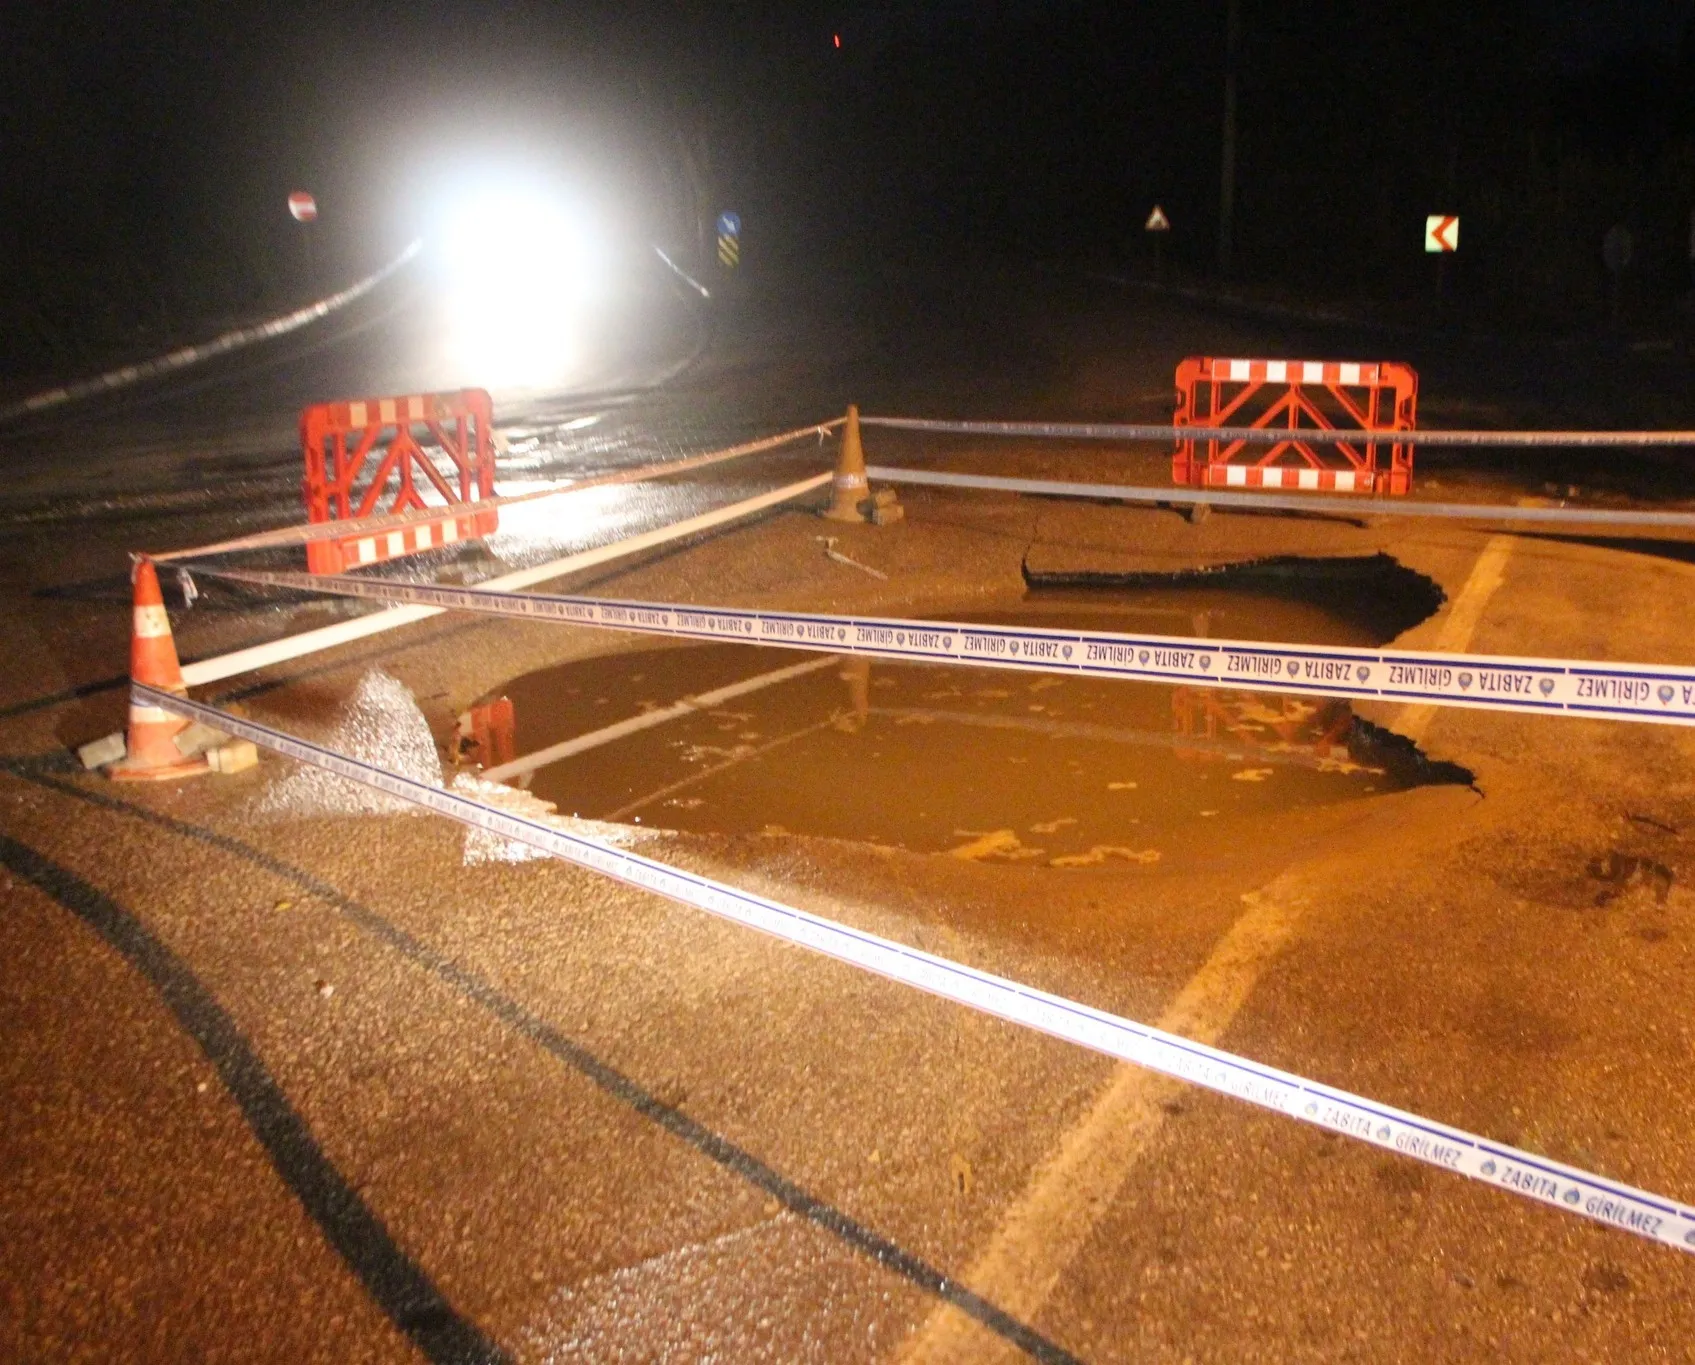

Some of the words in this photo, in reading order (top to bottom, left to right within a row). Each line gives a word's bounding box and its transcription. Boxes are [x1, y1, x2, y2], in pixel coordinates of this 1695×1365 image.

[807, 625, 835, 640] ZABITA
[856, 628, 893, 645] GİRİLMEZ
[909, 633, 939, 648] ZABITA
[964, 636, 1006, 655] GİRİLMEZ
[1023, 641, 1058, 658] ZABITA
[1086, 645, 1134, 665] GİRİLMEZ
[1155, 650, 1194, 669] ZABITA
[1227, 655, 1282, 678] GİRİLMEZ
[1305, 660, 1352, 681] ZABITA
[1389, 666, 1452, 691] GİRİLMEZ
[1479, 672, 1533, 694] ZABITA
[1576, 677, 1650, 705] GİRİLMEZ
[1322, 1107, 1371, 1136] ZABITA
[1395, 1130, 1463, 1168] GİRİLMEZ
[1500, 1165, 1558, 1200] ZABITA
[1586, 1195, 1664, 1236] GİRİLMEZ
